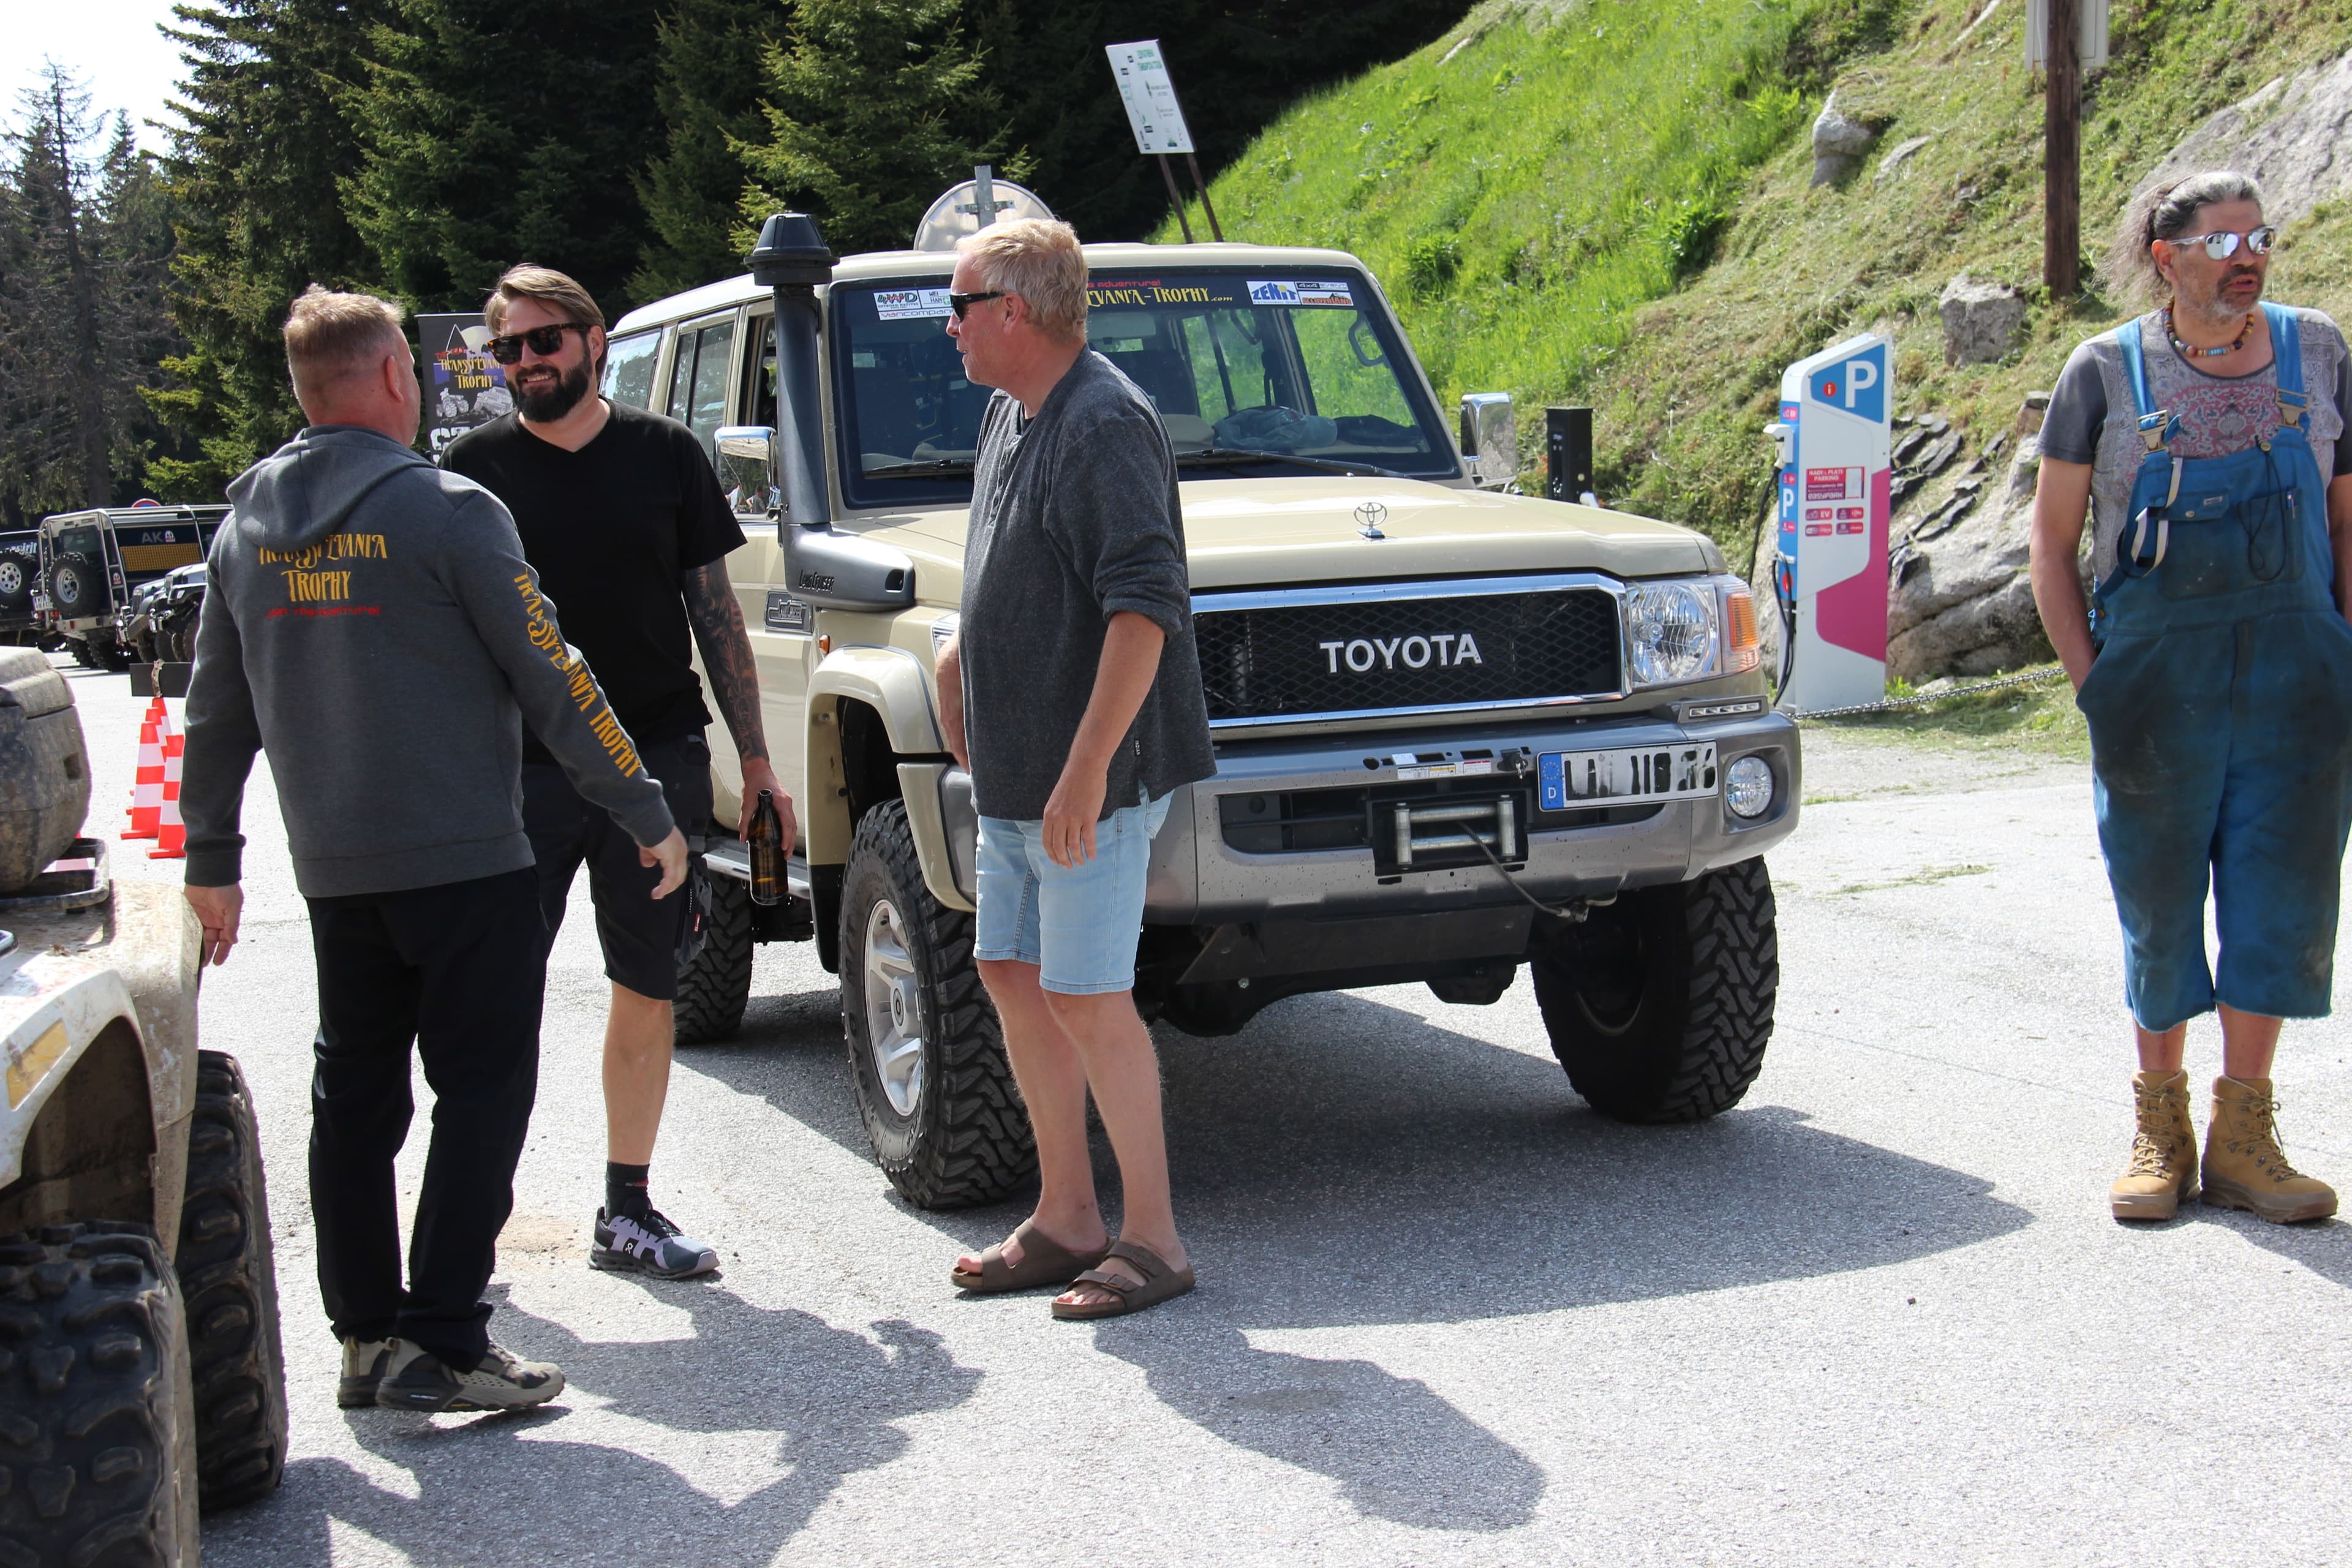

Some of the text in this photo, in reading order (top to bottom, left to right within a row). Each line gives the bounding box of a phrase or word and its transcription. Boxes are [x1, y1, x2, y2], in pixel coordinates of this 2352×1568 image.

[1845, 360, 1877, 409] P
[1783, 488, 1794, 518] P
[281, 570, 351, 602] TROPHY
[1320, 633, 1483, 673] TOYOTA
[589, 702, 642, 778] TROPHY
[1548, 787, 1556, 799] D
